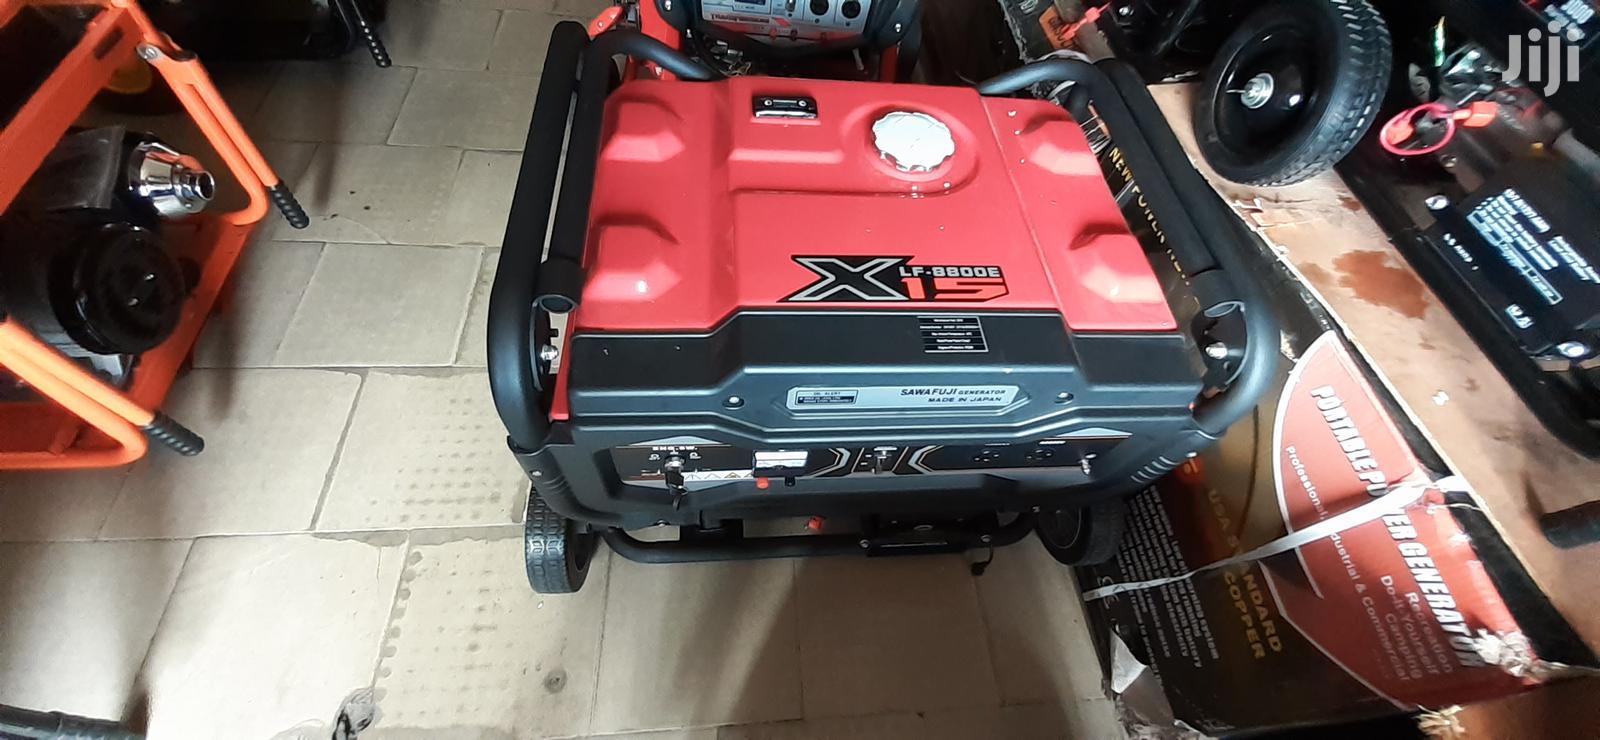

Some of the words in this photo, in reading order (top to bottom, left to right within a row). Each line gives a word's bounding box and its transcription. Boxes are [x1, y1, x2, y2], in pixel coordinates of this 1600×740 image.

[1109, 148, 1133, 182] NEW
[899, 266, 1000, 278] LF-8800E
[900, 388, 957, 396] SAWAFUJI
[1310, 385, 1378, 472] PORTABLE
[1358, 470, 1418, 540] POER
[1224, 568, 1266, 658] COPPER
[1355, 583, 1368, 594] &
[1362, 597, 1411, 682] Commercial
[1386, 613, 1422, 679] Camping
[1405, 592, 1453, 673] Recreation
